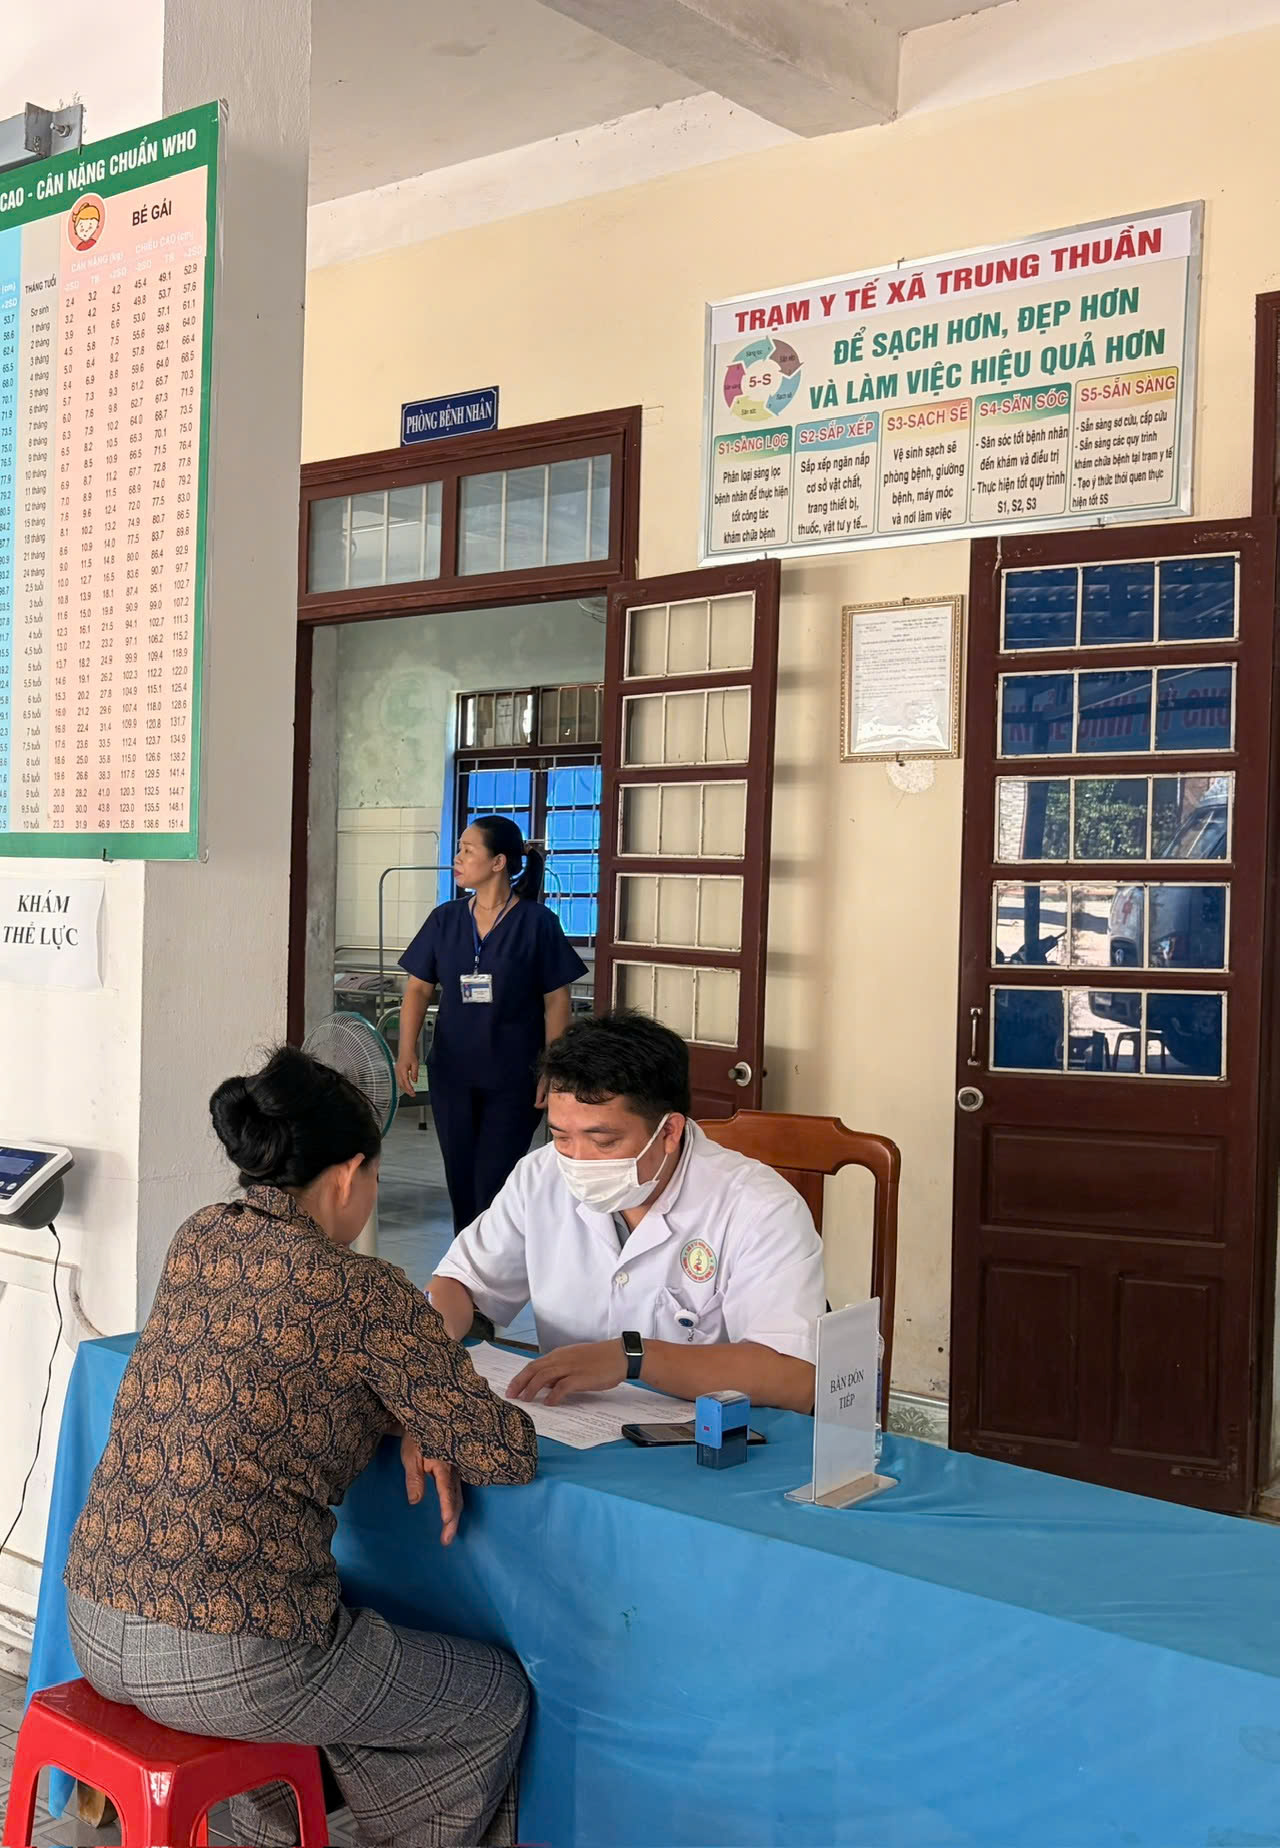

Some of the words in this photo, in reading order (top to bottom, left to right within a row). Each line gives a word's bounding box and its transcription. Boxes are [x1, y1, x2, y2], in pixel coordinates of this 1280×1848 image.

[0, 187, 24, 212] CAO
[37, 172, 63, 200] CÂN
[67, 161, 105, 191] NẶNG
[110, 136, 157, 175] CHUẨN
[162, 129, 197, 158] WHO
[132, 204, 148, 226] BÉ
[151, 198, 172, 220] GÁI
[25, 280, 43, 294] THÁNG
[44, 273, 56, 288] TUỔI
[735, 299, 810, 333] TRẠM
[820, 294, 836, 317] Y
[845, 278, 880, 312] TẾ
[886, 272, 926, 305] XÃ
[936, 253, 1040, 295] TRUNG
[1050, 225, 1162, 272] THUẦN
[833, 326, 866, 365] ĐỂ
[872, 323, 939, 361] SẠCH
[947, 312, 1008, 345] HƠN,
[1017, 300, 1071, 335] ĐẸP
[1080, 286, 1139, 322] HƠN
[749, 373, 772, 388] 5-S
[809, 379, 838, 410] VÀ
[846, 373, 898, 404] LÀM
[907, 361, 962, 396] VIỆC
[970, 348, 1031, 386] HIỆU
[1040, 332, 1096, 375] QUẢ
[1105, 328, 1165, 363] HƠN
[1081, 376, 1131, 402] S5-SẴN
[1135, 375, 1175, 394] SÀNG
[980, 394, 1032, 416] S4-SĂN
[1036, 389, 1068, 409] SÓC
[406, 409, 437, 434] PHÒNG
[439, 403, 464, 431] BỆNH
[465, 396, 492, 423] NHÂN
[887, 410, 945, 430] S3-SẠCH
[950, 403, 968, 422] SẼ
[800, 420, 844, 443] S2-SẮP
[848, 415, 873, 437] XẾP
[981, 436, 995, 449] Săn
[998, 433, 1011, 447] sóc
[1013, 430, 1024, 445] tốt
[1026, 429, 1046, 445] bệnh
[1048, 426, 1068, 440] nhân
[718, 436, 763, 455] S1-SÀNG
[766, 434, 787, 451] LỌC
[893, 448, 904, 462] Vệ
[906, 446, 923, 459] sinh
[925, 443, 945, 459] sạch
[947, 441, 957, 454] sẽ
[801, 458, 815, 474] Sắp
[817, 456, 831, 472] xếp
[833, 456, 853, 471] ngăn
[855, 451, 870, 467] nắp
[980, 456, 995, 471] đến
[997, 455, 1018, 469] khám
[1020, 452, 1029, 466] và
[1031, 449, 1048, 465] điều
[1050, 449, 1059, 464] trị
[806, 482, 816, 493] cơ
[817, 477, 827, 492] sở
[829, 477, 841, 492] vật
[843, 473, 862, 489] chất,
[883, 470, 909, 487] phòng
[911, 466, 933, 483] bệnh,
[936, 463, 965, 480] giường
[977, 481, 996, 495] Thực
[998, 477, 1015, 493] hiện
[1017, 473, 1027, 489] tốt
[1029, 476, 1044, 491] quy
[1046, 471, 1065, 486] trình
[808, 503, 828, 515] trang
[830, 496, 847, 511] thiết
[849, 497, 859, 511] bị,
[892, 491, 914, 507] bệnh,
[917, 488, 934, 503] máy
[936, 485, 954, 499] móc
[997, 500, 1010, 514] S1,
[1012, 499, 1024, 512] S2,
[1026, 497, 1037, 510] S3
[798, 520, 821, 535] thuốc,
[823, 520, 835, 534] vật
[837, 519, 846, 531] tư
[846, 521, 852, 533] y
[892, 513, 901, 525] và
[903, 511, 916, 524] nơi
[918, 510, 932, 522] làm
[935, 507, 952, 522] việc
[17, 889, 71, 914] KHÁM
[3, 921, 36, 945] THỂ
[40, 924, 79, 950] LỰC
[830, 1374, 846, 1393] BÀN
[848, 1368, 864, 1387] ĐÓN
[839, 1392, 855, 1409] TIẾP
